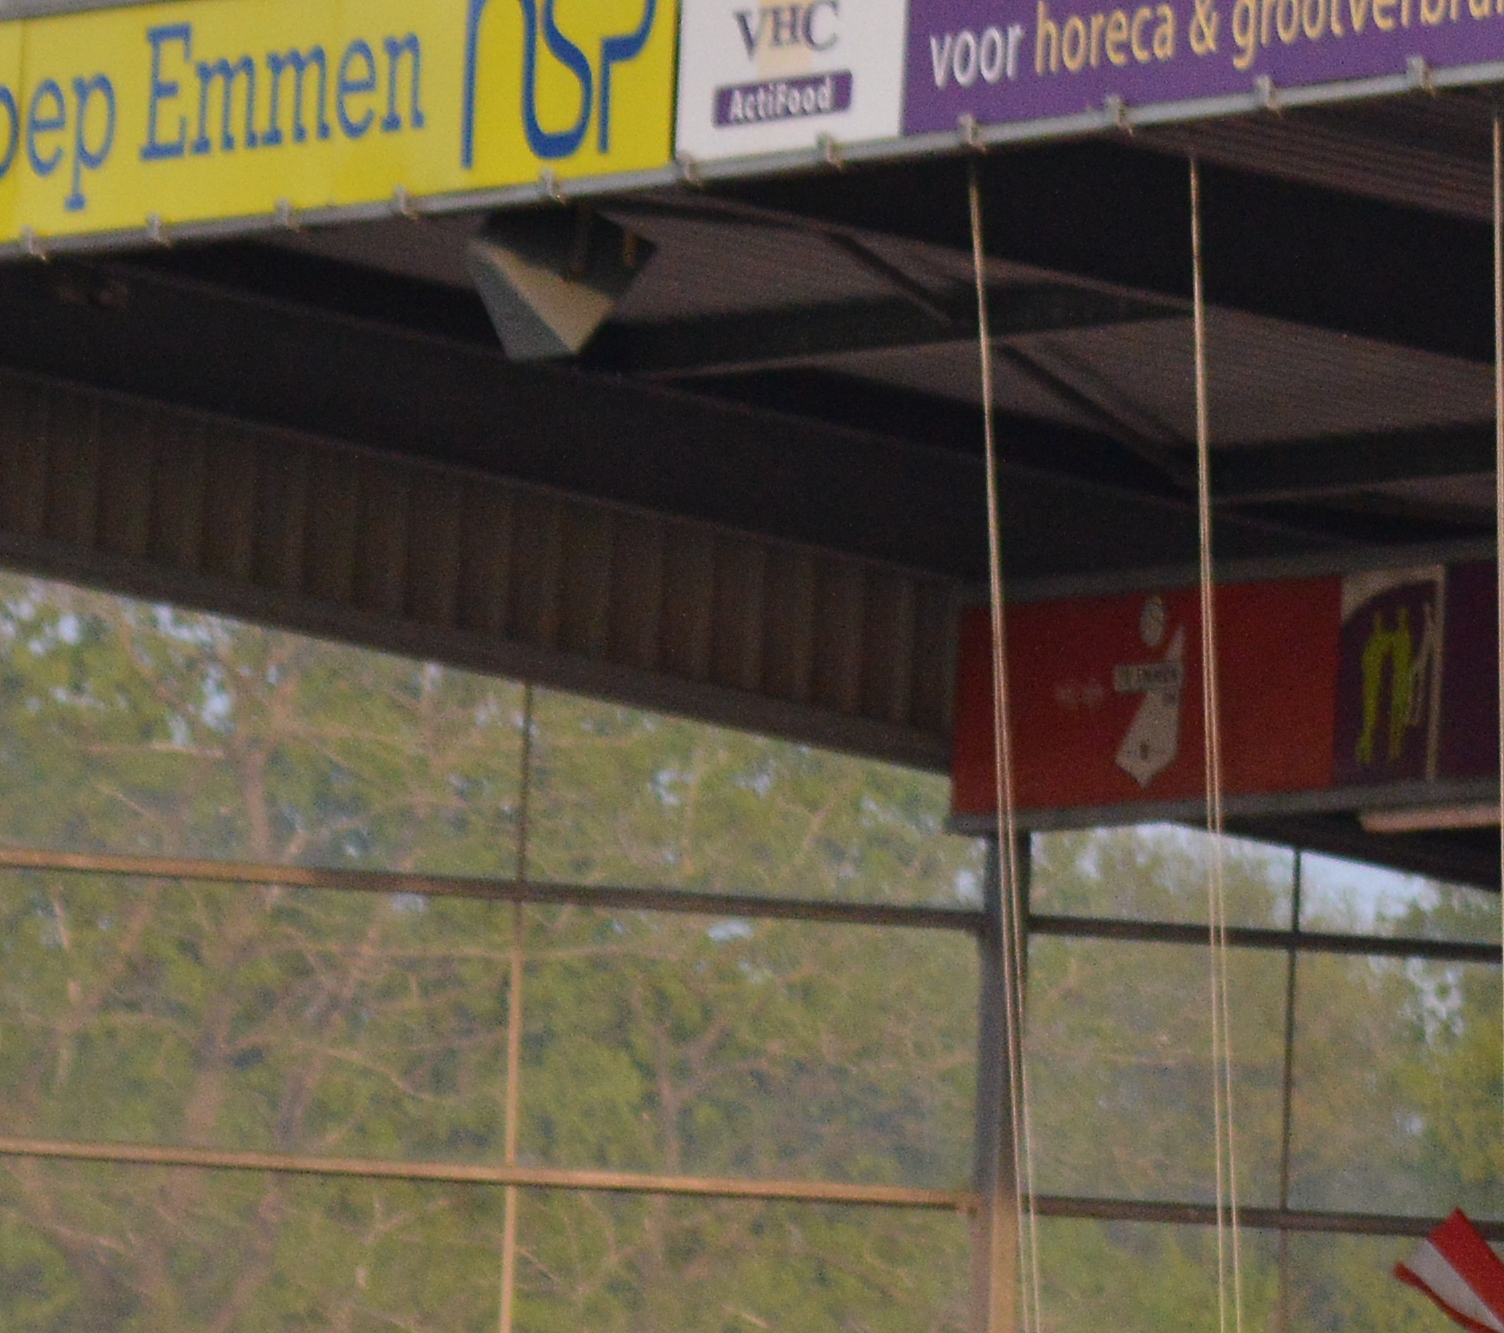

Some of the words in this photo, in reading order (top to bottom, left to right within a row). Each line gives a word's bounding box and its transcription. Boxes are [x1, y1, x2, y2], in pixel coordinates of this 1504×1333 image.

[930, 22, 1026, 90] voor
[1034, 0, 1177, 77] horeca
[1190, 2, 1220, 56] &
[139, 23, 426, 162] Emmen
[728, 76, 833, 123] ActiFood
